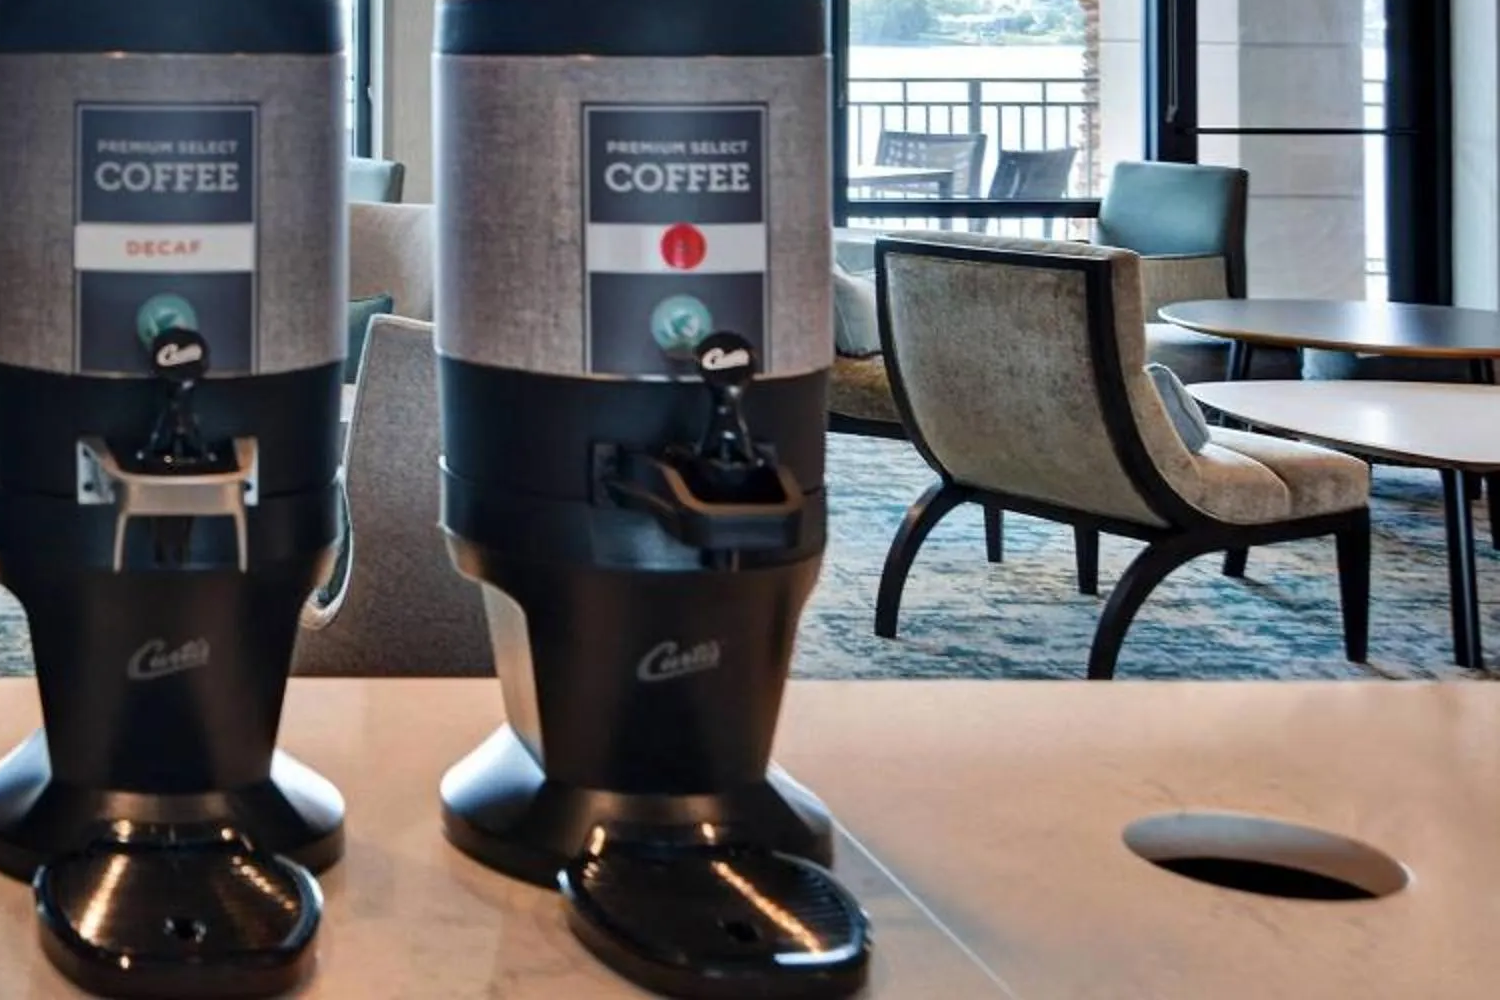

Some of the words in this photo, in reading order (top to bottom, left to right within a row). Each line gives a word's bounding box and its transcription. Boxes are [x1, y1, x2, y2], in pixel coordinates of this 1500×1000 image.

[97, 139, 174, 154] PREMIUM
[177, 139, 238, 155] SELECT
[606, 139, 686, 154] PREMIUM
[690, 139, 748, 155] SELECT
[95, 160, 240, 193] COFFEE
[605, 161, 751, 193] COFFEE
[124, 239, 202, 258] DECAF
